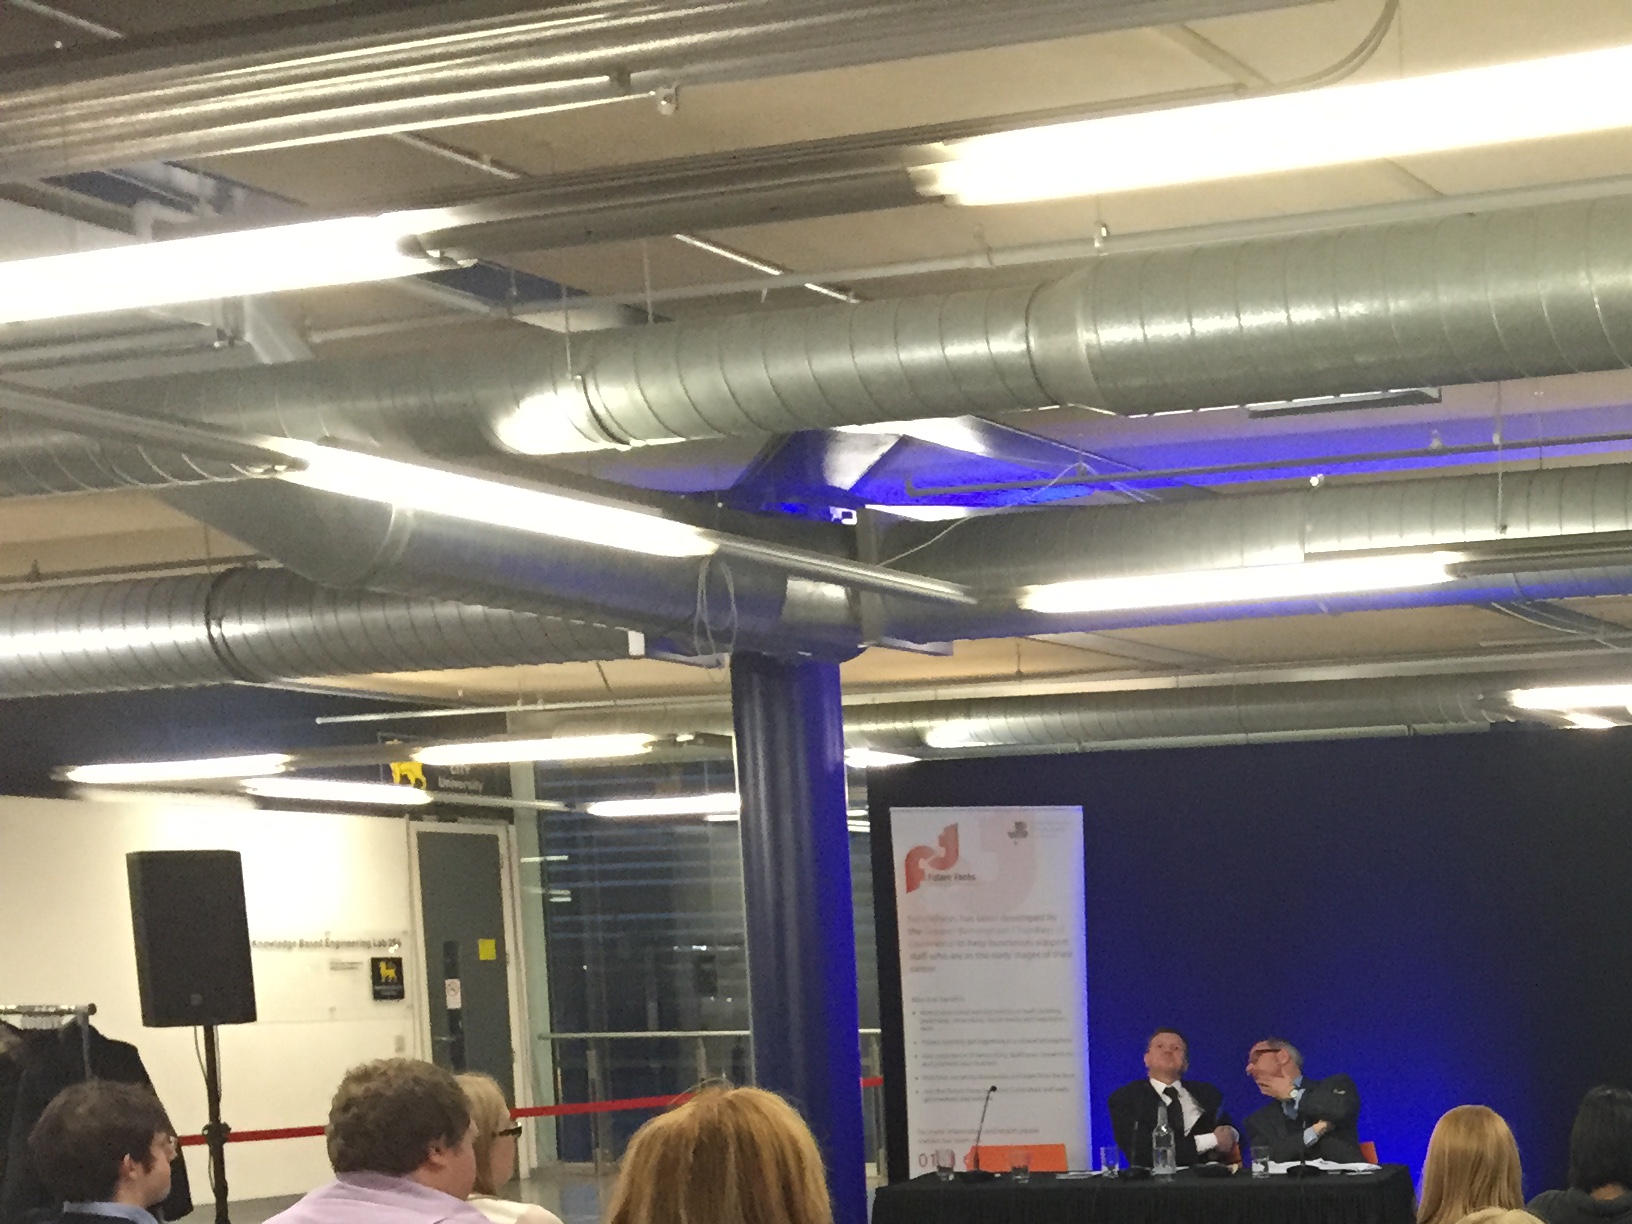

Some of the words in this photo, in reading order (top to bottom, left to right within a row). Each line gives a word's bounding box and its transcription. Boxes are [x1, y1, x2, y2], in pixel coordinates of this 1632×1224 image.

[438, 776, 483, 793] University
[252, 940, 297, 951] Knowledge
[299, 939, 323, 949] Based
[325, 938, 371, 951] Engineering
